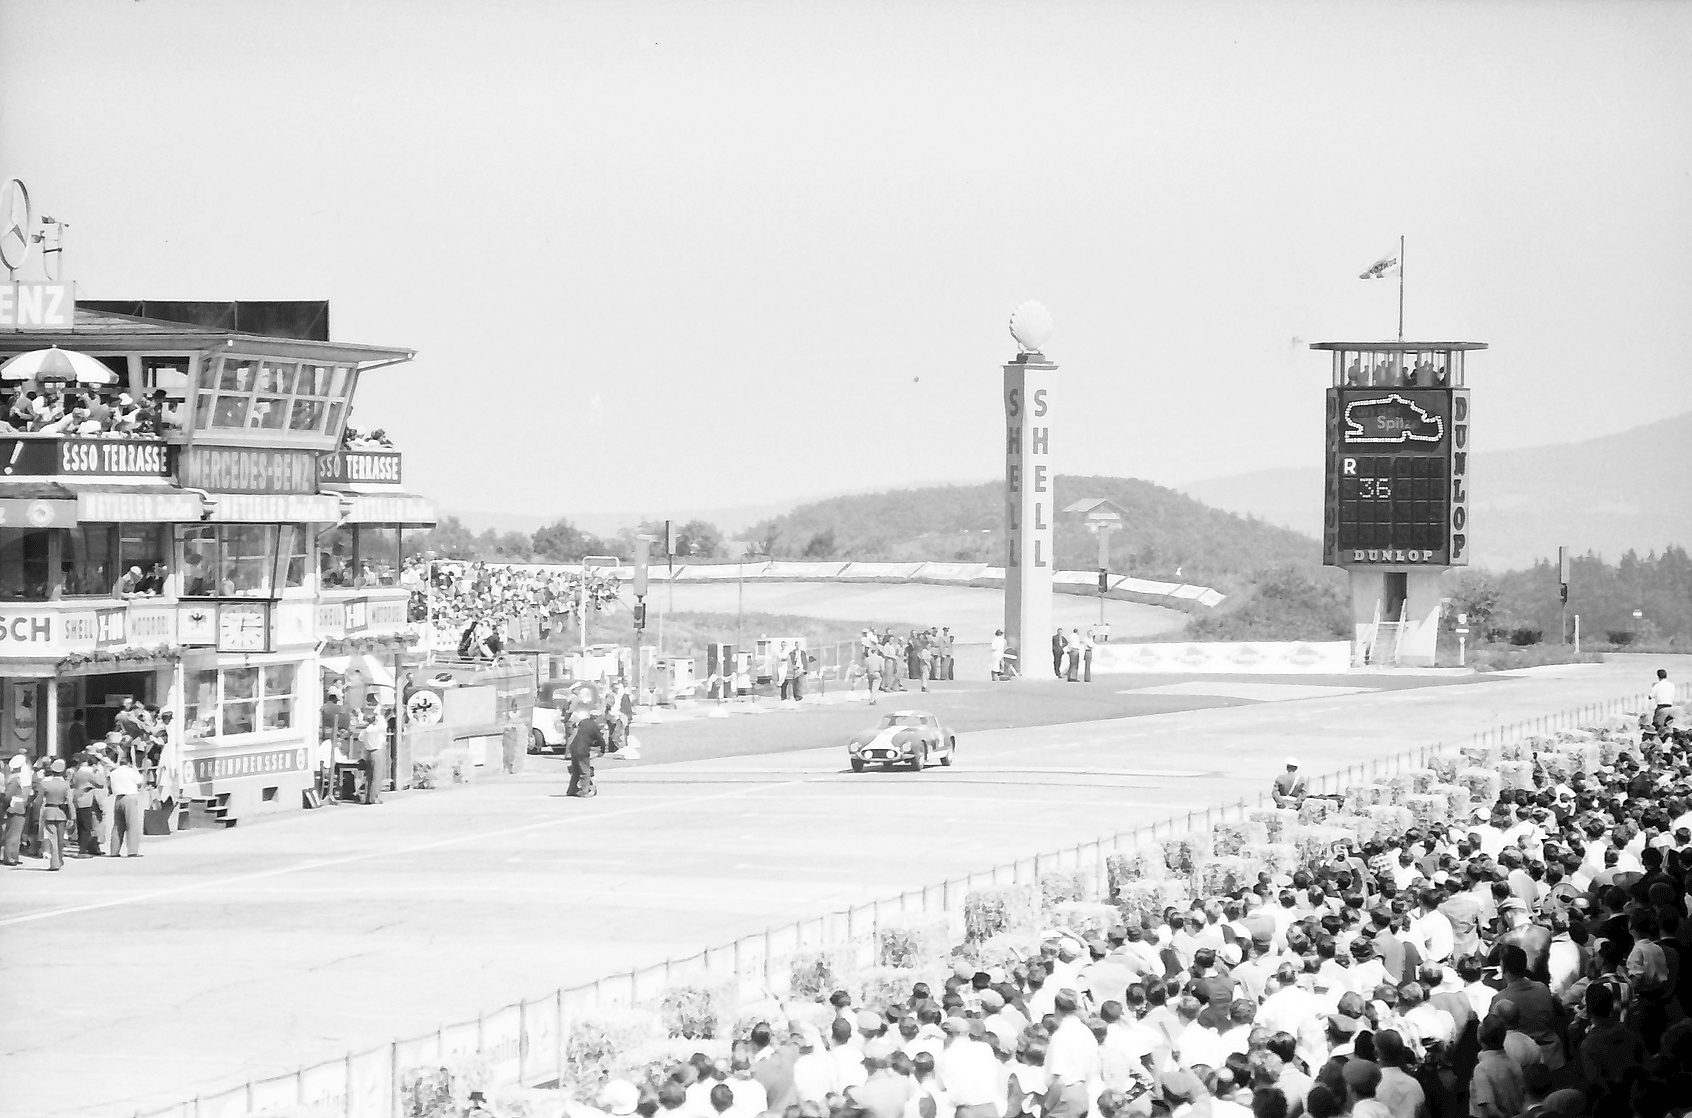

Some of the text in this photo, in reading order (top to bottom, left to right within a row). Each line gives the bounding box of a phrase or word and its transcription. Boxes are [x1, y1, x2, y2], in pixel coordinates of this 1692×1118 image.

[63, 441, 168, 472] ESSO TERRASSE
[346, 454, 399, 480] TERRASSE
[1344, 458, 1357, 475] R
[188, 451, 310, 491] MERCEDES-BENZ
[1008, 387, 1020, 568] SHELL
[1033, 389, 1049, 568] SHELL
[1453, 397, 1467, 558] DUNLOP
[1359, 478, 1391, 498] 36
[1354, 550, 1433, 562] DUNLOP
[65, 619, 93, 639] SHELL
